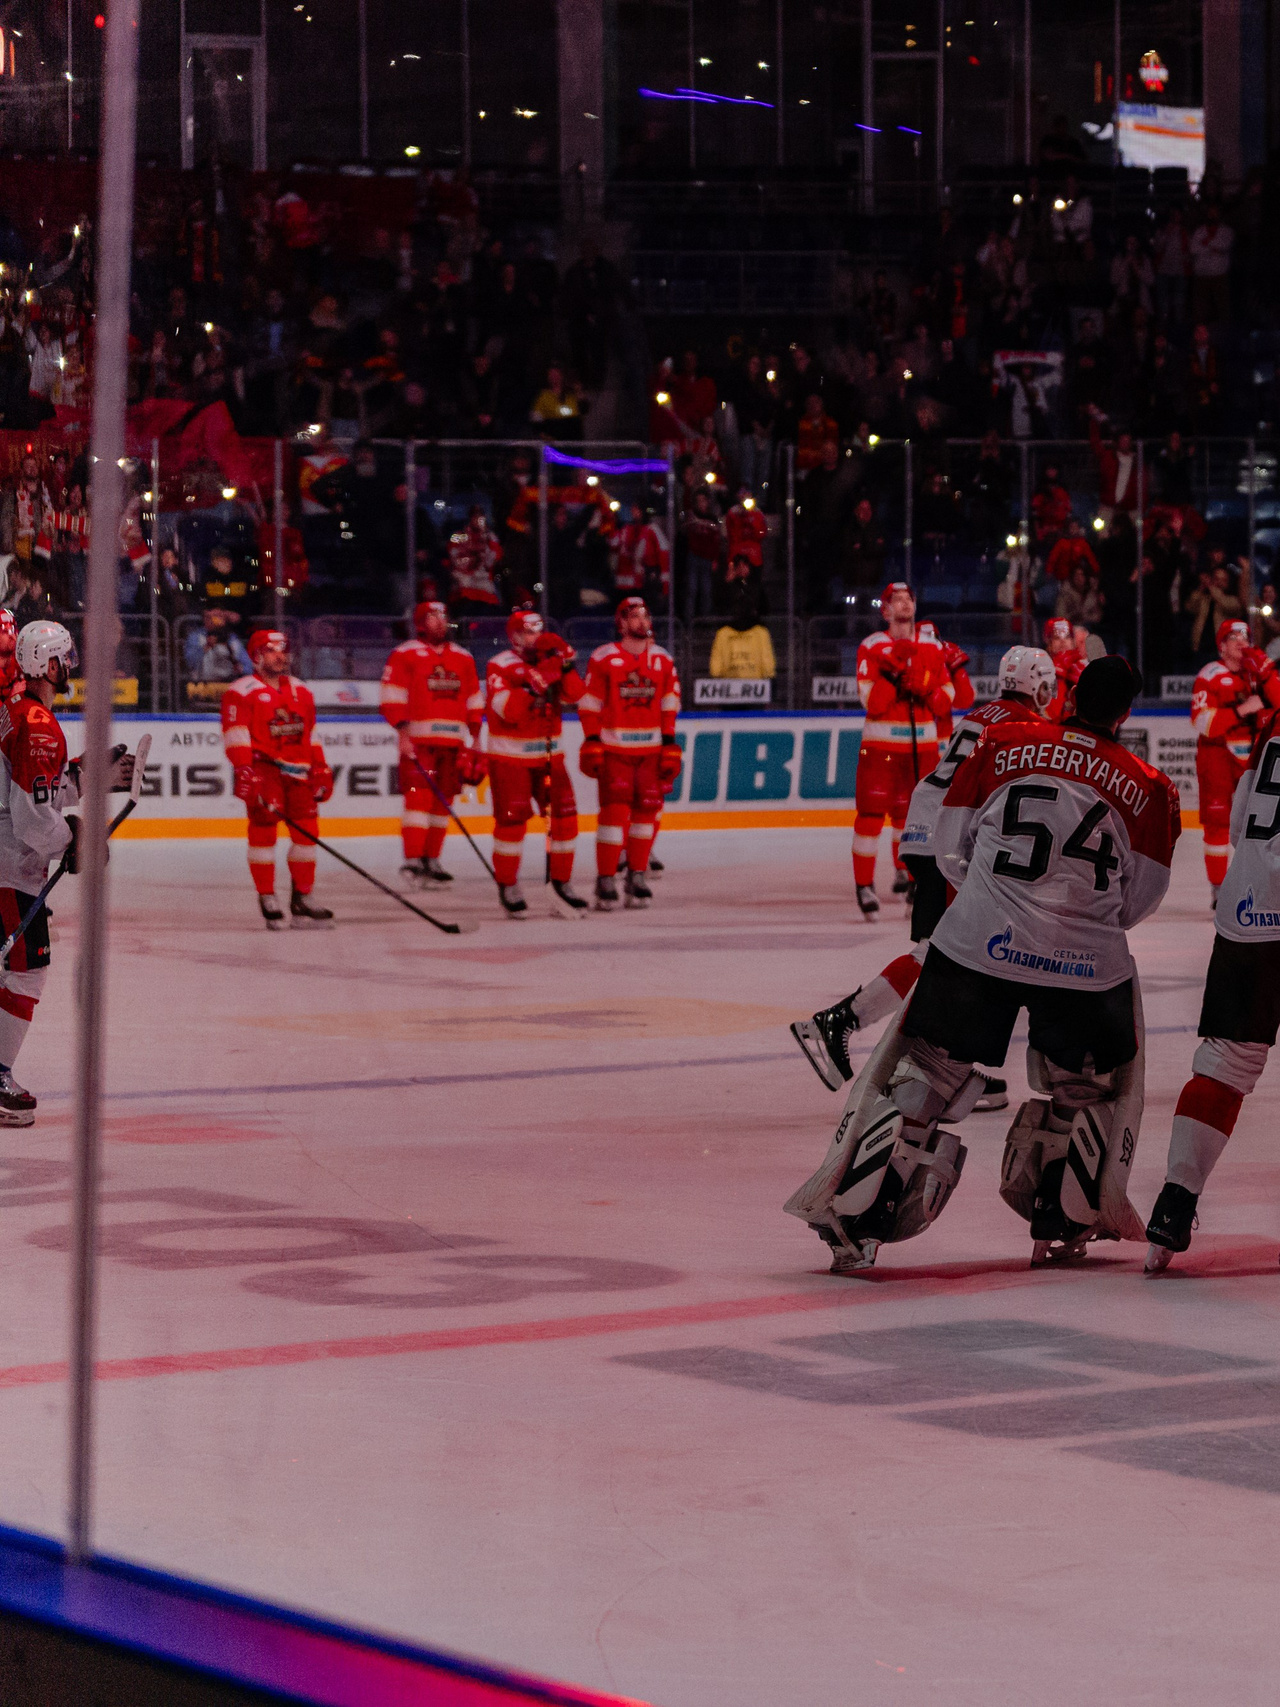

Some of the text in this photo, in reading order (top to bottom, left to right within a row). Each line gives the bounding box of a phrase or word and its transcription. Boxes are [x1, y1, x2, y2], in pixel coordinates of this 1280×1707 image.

[700, 683, 766, 698] KHL.RU
[968, 703, 1011, 724] POV
[994, 743, 1150, 818] SEREBRYAKOV
[992, 784, 1119, 892] 54
[1008, 950, 1095, 978] ГАЗПРОМНЕФТЬ
[1053, 950, 1096, 962] СЕТЬ АЗС
